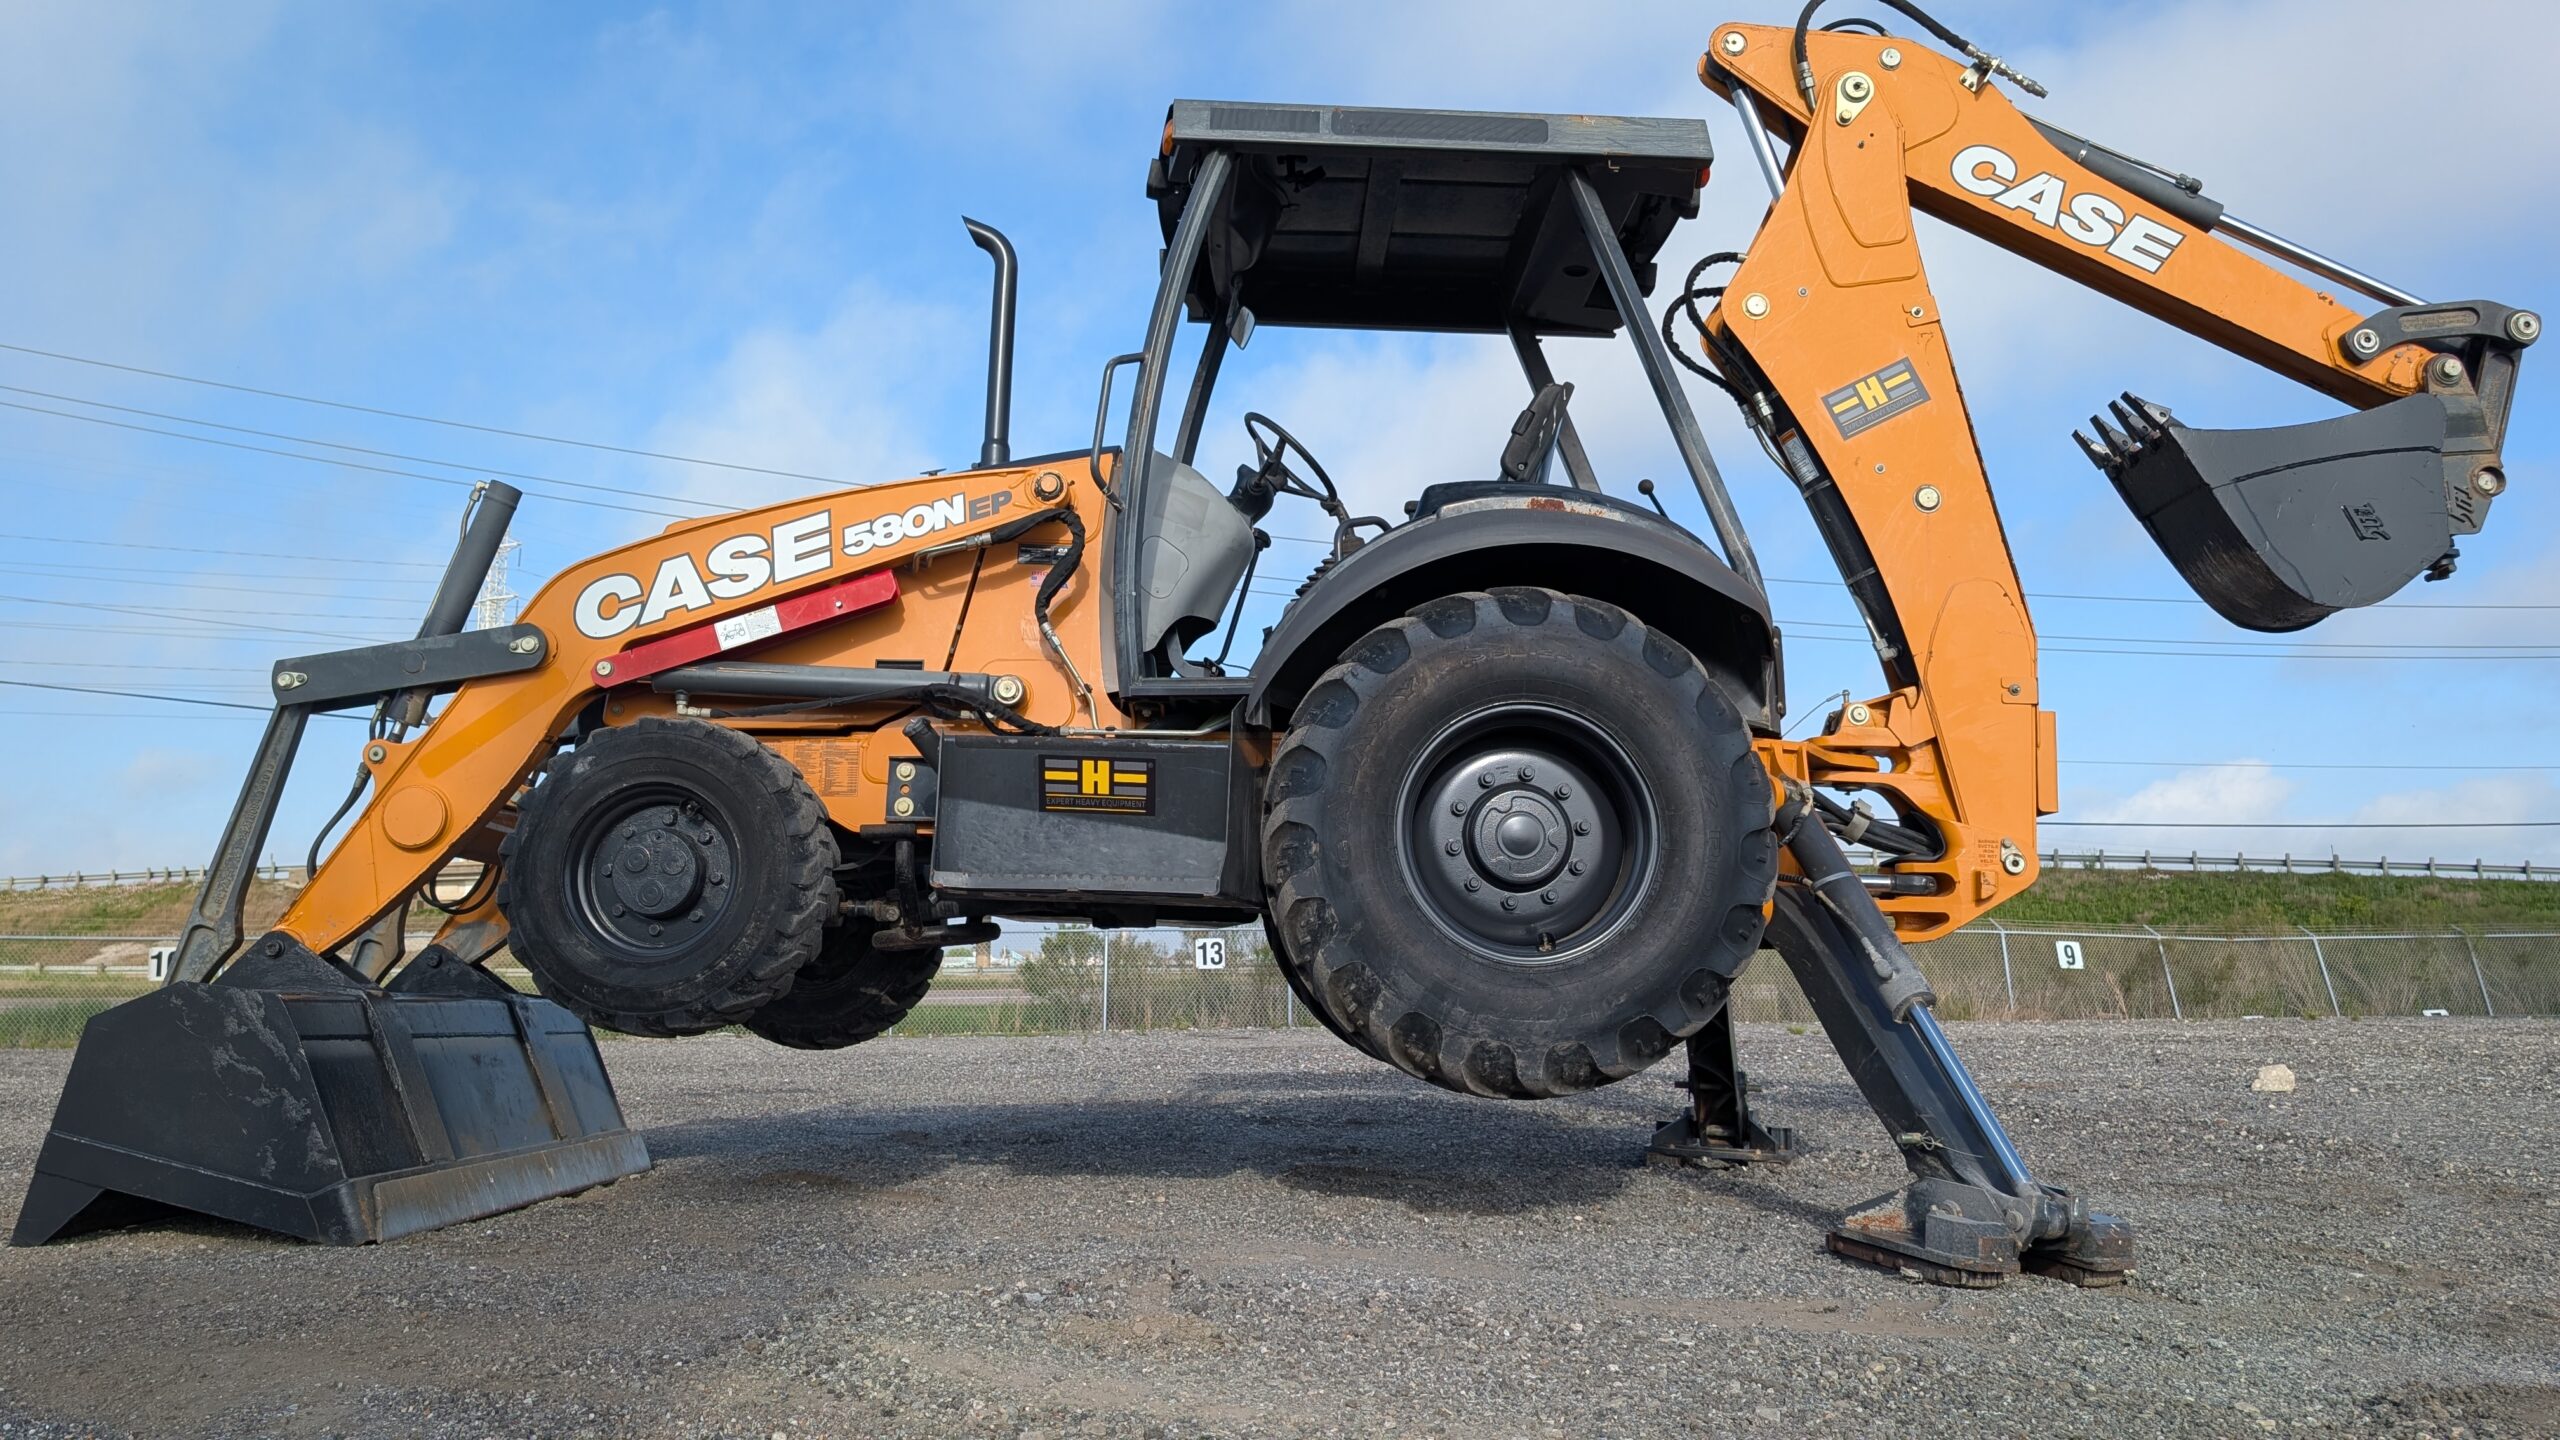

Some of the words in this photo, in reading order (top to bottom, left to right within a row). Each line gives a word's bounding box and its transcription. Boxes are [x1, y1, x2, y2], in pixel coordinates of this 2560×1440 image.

[1950, 144, 2187, 275] CASE
[1855, 376, 1889, 410] H
[574, 508, 832, 640] CASE
[842, 493, 966, 556] 580N
[968, 489, 1013, 522] EP
[1082, 759, 1110, 795] H
[1046, 797, 1074, 806] EXPERT
[1075, 798, 1101, 807] HEAVY
[1101, 799, 1146, 808] EQUIPMENT
[1197, 941, 1223, 966] 13
[2063, 944, 2076, 966] 9
